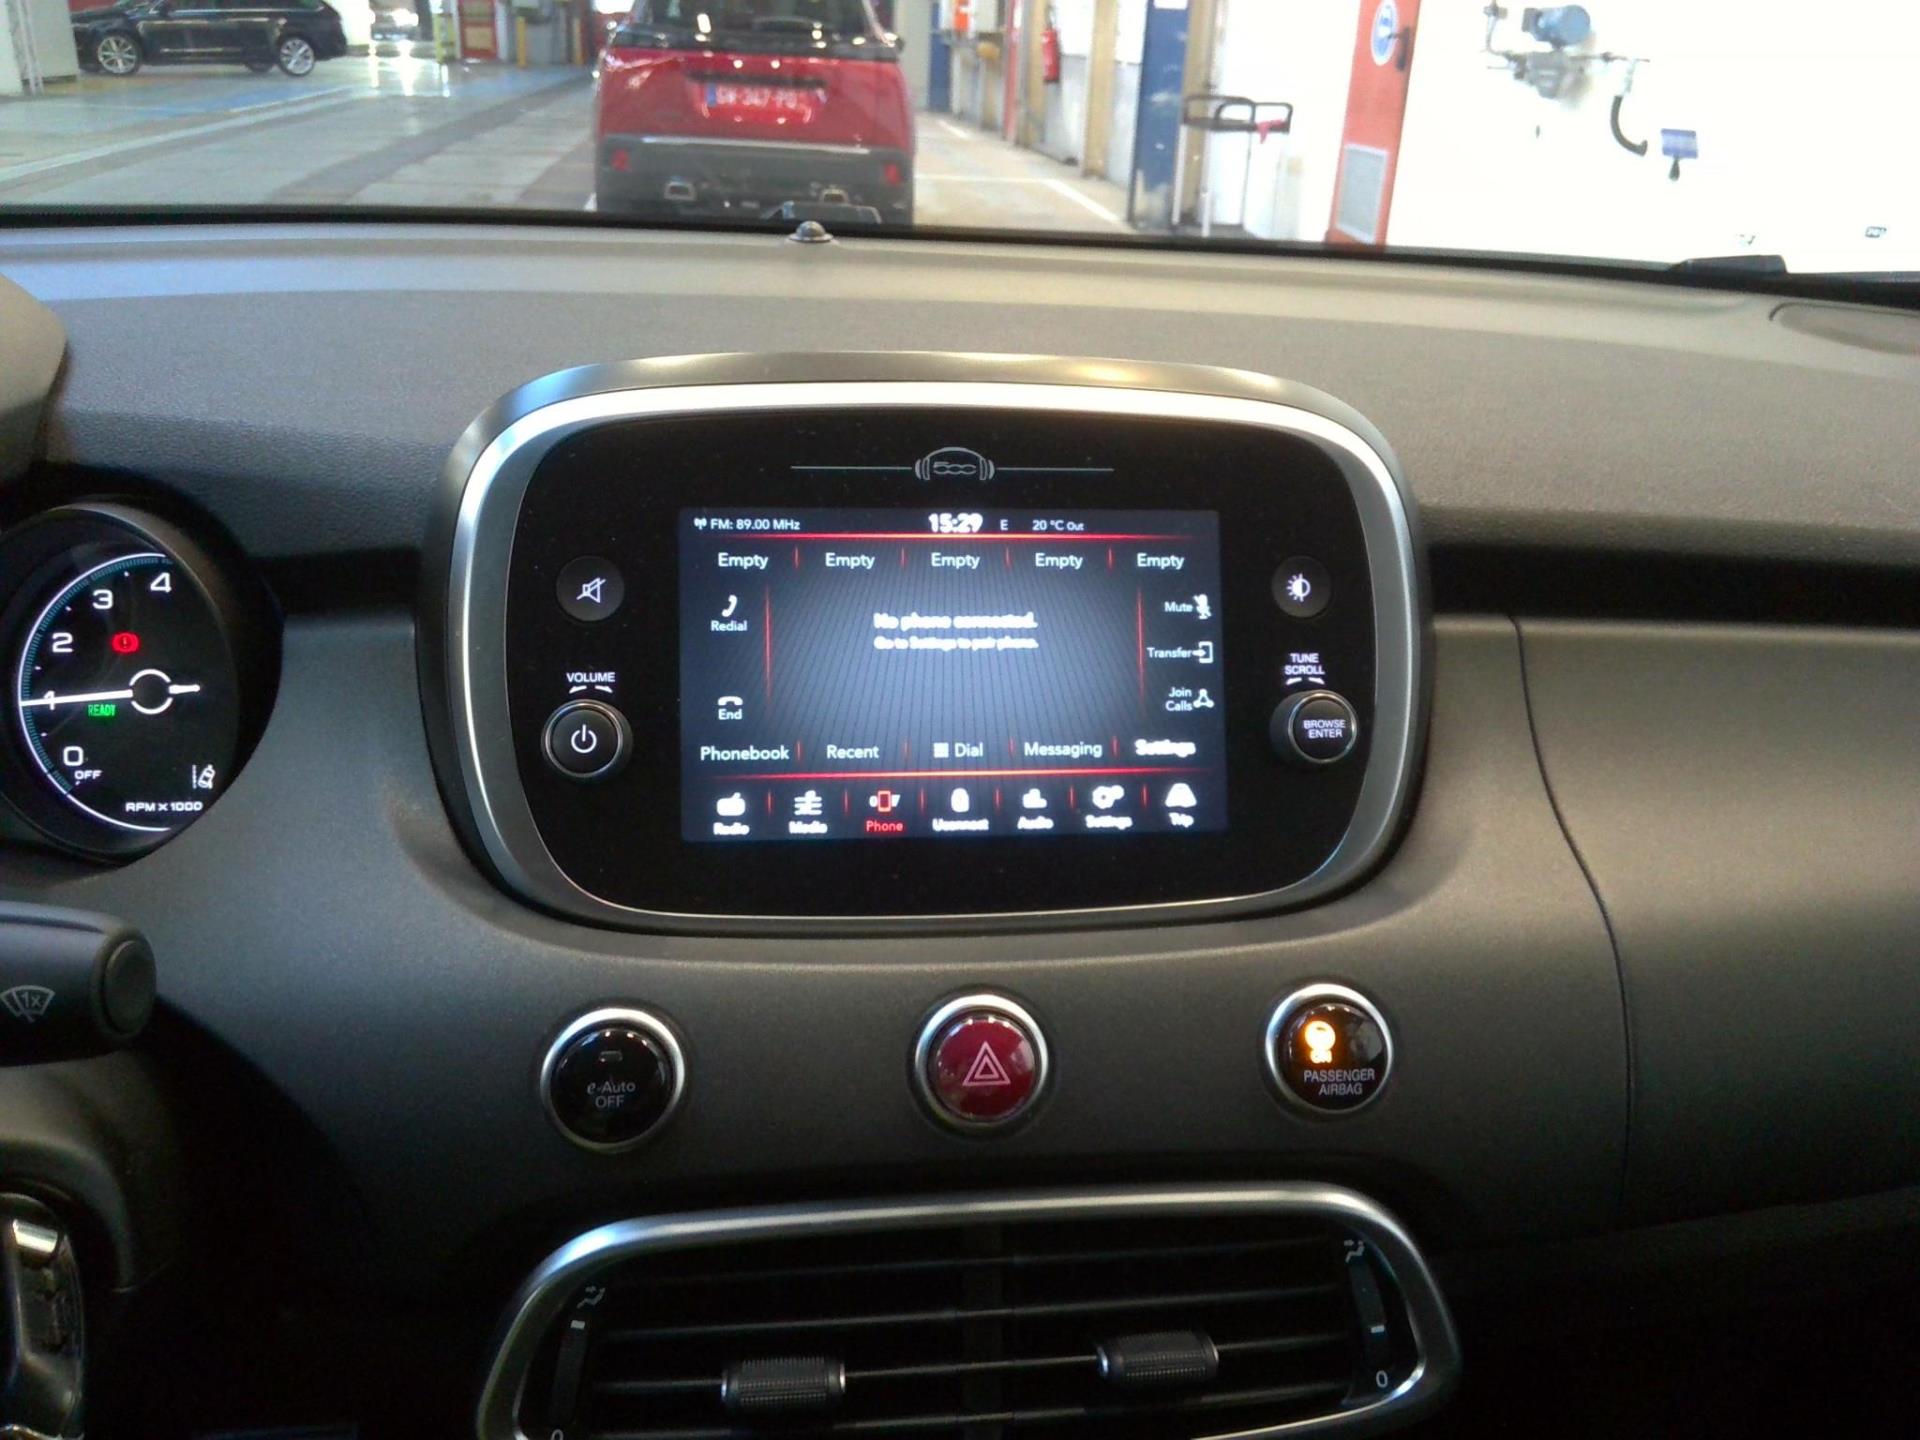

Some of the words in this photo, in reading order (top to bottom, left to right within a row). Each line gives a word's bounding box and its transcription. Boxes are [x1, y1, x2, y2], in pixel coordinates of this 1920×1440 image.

[710, 518, 734, 530] FM:
[736, 518, 770, 530] 89.00
[773, 518, 800, 530] MHz
[928, 513, 984, 534] 15:29
[1000, 519, 1009, 531] E
[1032, 519, 1047, 531] 20
[1066, 521, 1085, 532] Out
[717, 552, 769, 570] Empty
[825, 552, 875, 570] Empty
[930, 552, 980, 570] Empty
[1035, 552, 1083, 570] Empty
[1136, 552, 1185, 570] Empty
[149, 571, 173, 593] 4
[92, 588, 114, 610] 3
[1164, 601, 1193, 614] Mute
[710, 619, 748, 632] Redial
[52, 631, 74, 654] 2
[1147, 646, 1193, 659] Transfer
[1290, 653, 1319, 663] TUNE
[1284, 665, 1325, 675] SCROLL
[565, 671, 616, 683] VOLUME
[1168, 687, 1193, 699] Join
[87, 703, 117, 717] READY
[1165, 700, 1193, 713] Calls
[718, 708, 743, 720] End
[1303, 719, 1346, 729] BROWSE
[1308, 729, 1343, 739] ENTER
[700, 744, 790, 762] Phonebook
[826, 744, 880, 760] Recent
[954, 742, 984, 758] Dial
[1023, 742, 1103, 759] Messaging
[74, 769, 103, 780] OFF
[125, 801, 156, 813] RPM
[170, 801, 204, 812] 1000
[866, 820, 904, 833] Phone
[1303, 1068, 1376, 1083] PASSENGER
[1319, 1084, 1363, 1096] AIRBAG
[595, 1096, 625, 1108] OFF
